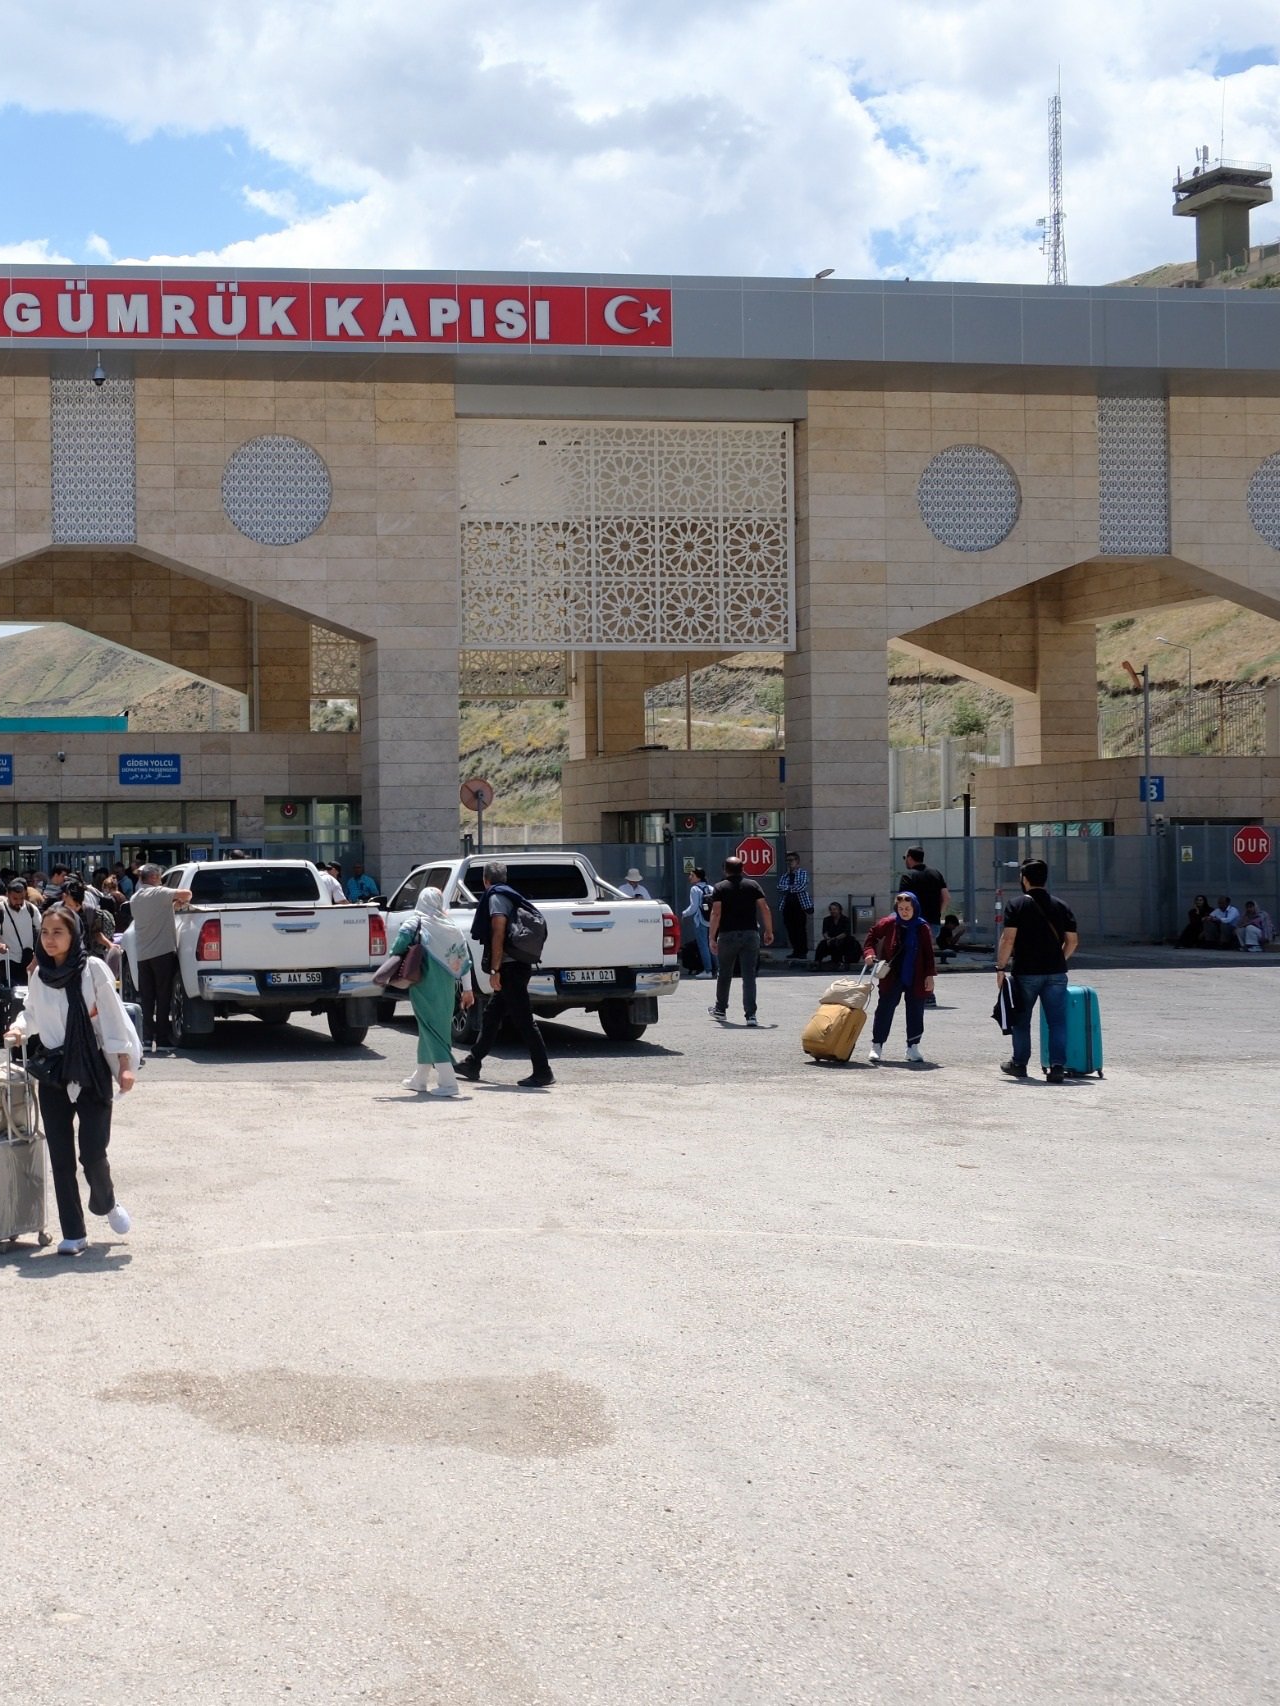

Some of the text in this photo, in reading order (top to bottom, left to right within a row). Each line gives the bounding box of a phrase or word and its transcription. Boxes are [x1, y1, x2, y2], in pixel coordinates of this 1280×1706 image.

[2, 280, 297, 336] GÜMRÜK
[324, 296, 550, 341] KAPISI
[126, 758, 173, 767] GİDEN YOLCU
[1237, 838, 1268, 853] DUR
[739, 849, 771, 864] DUR
[271, 972, 320, 983] 65 AAY 569
[566, 970, 614, 981] 65 AAY 021
